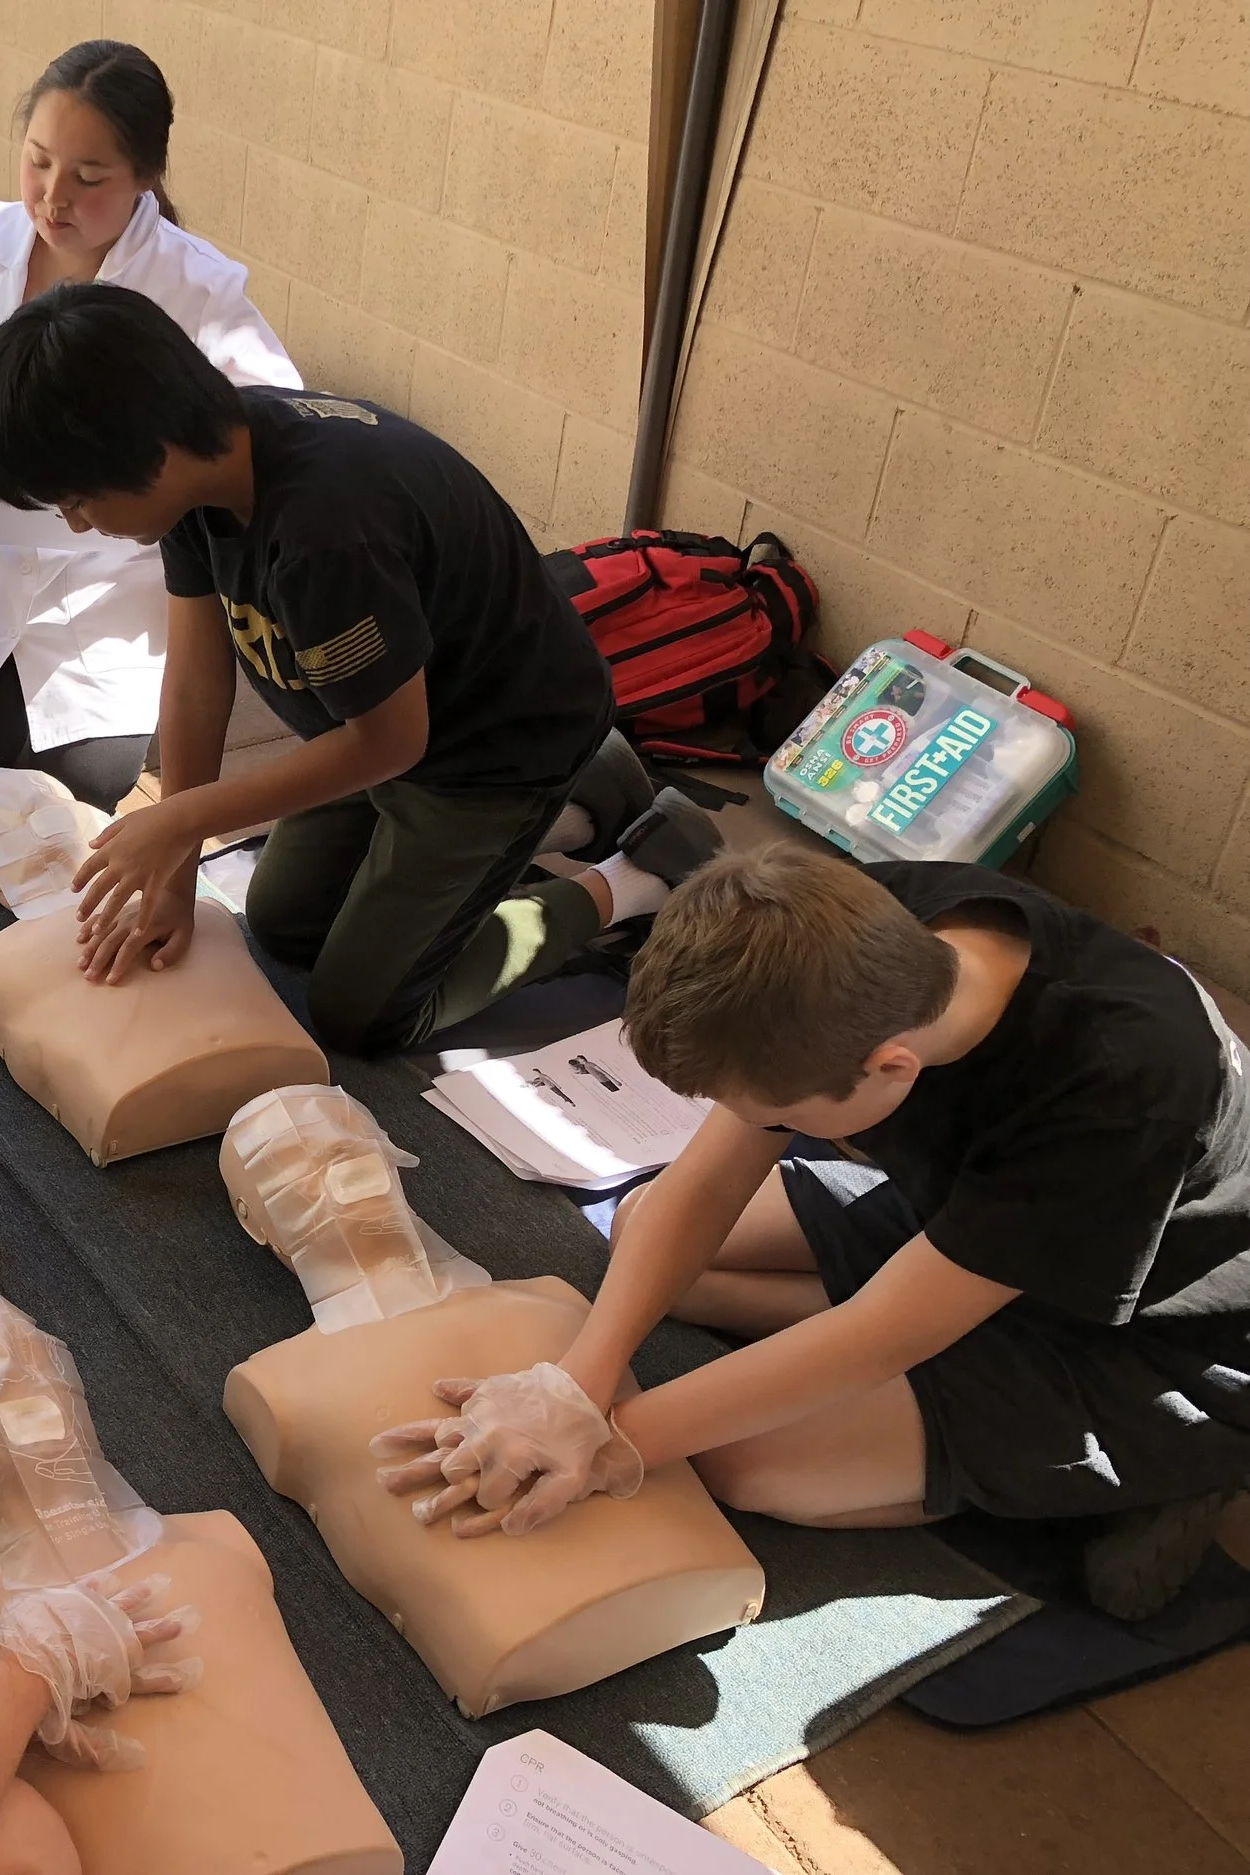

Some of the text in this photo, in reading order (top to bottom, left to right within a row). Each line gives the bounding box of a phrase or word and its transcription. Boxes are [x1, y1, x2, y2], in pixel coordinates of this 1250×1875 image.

[799, 749, 825, 776] OSHA
[807, 752, 831, 781] ANSI
[817, 759, 844, 787] 326
[871, 753, 949, 832] FIRST
[936, 709, 991, 761] AID
[87, 1498, 107, 1508] Sid
[519, 1753, 545, 1773] CPR
[526, 1811, 550, 1828] Ensure
[550, 1825, 565, 1838] that
[565, 1834, 577, 1846] the
[577, 1843, 601, 1861] person
[533, 1798, 545, 1808] not
[545, 1804, 577, 1828] breathing
[594, 1835, 609, 1847] only
[512, 1841, 528, 1853] Give
[530, 1848, 542, 1861] 30
